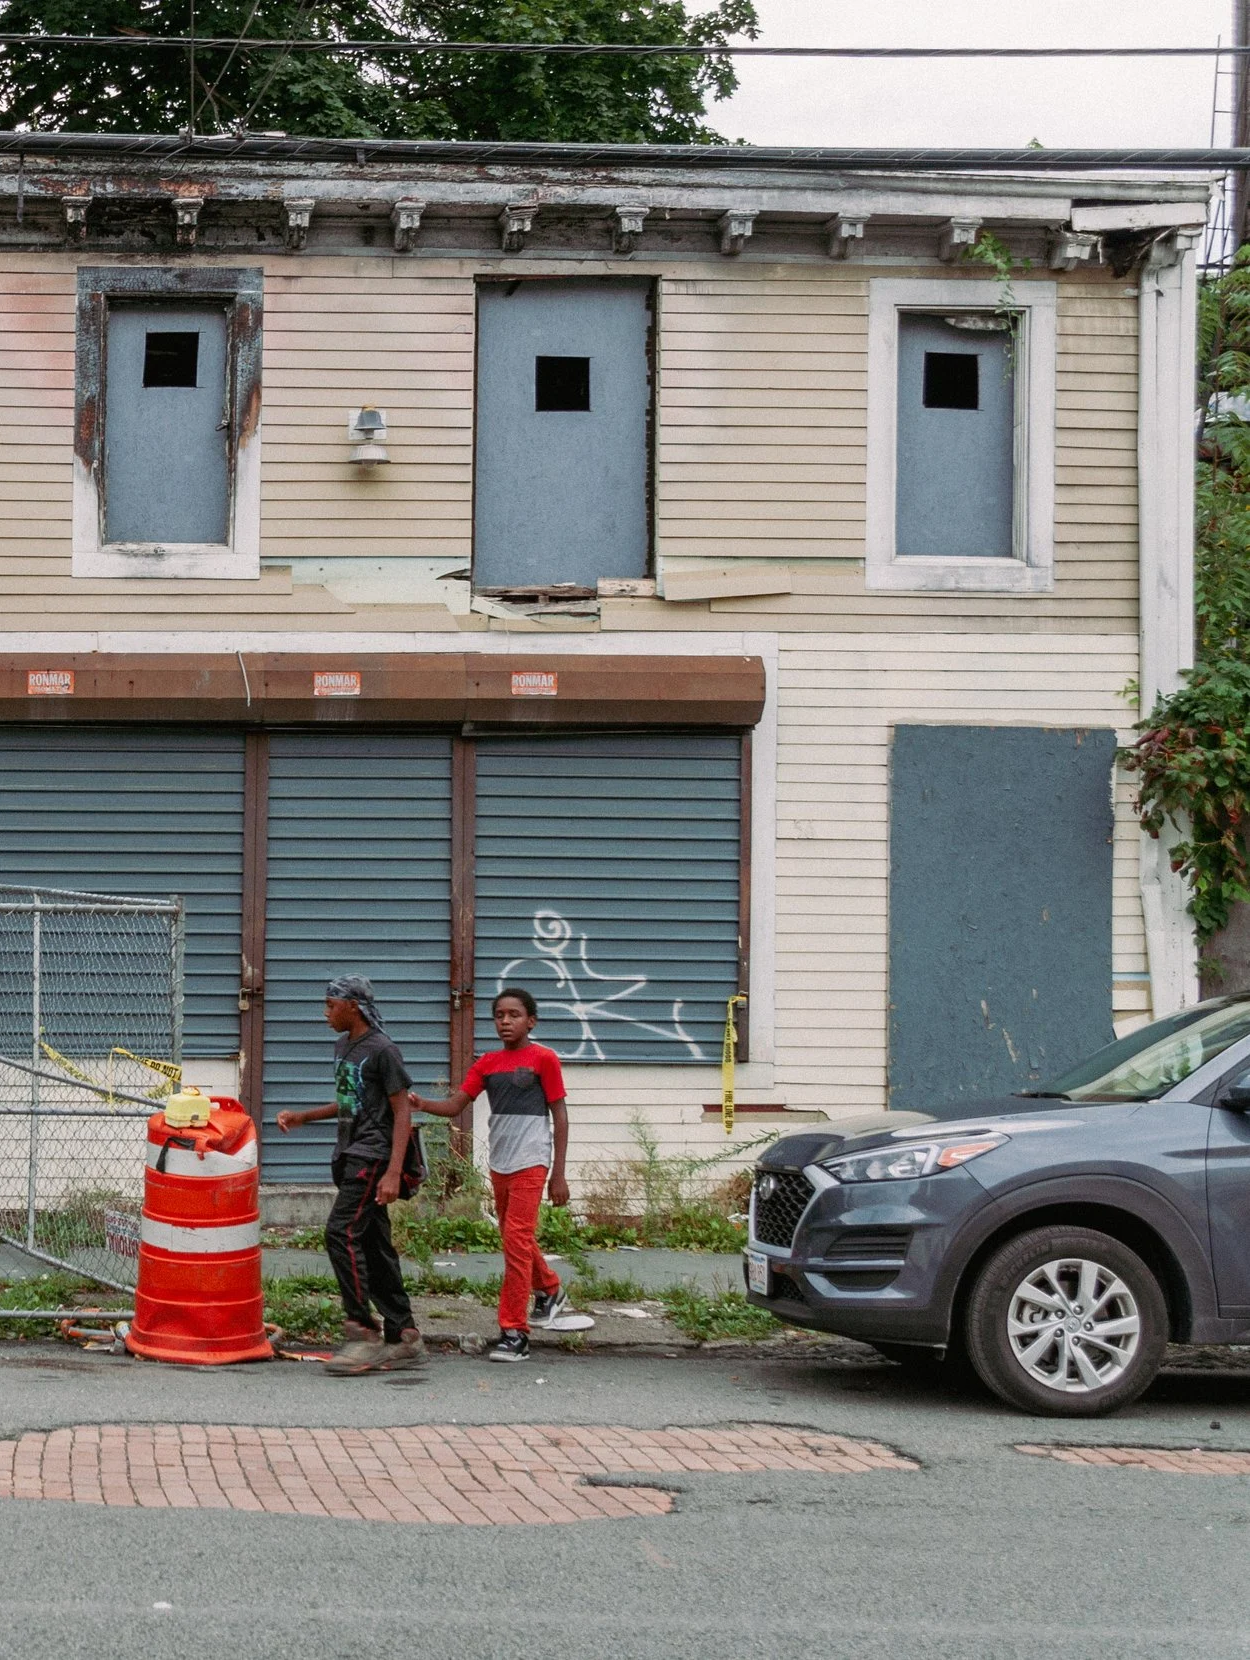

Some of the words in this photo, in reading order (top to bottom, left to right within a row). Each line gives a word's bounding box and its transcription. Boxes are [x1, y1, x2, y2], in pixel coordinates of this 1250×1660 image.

[29, 673, 71, 686] RONMAR
[315, 674, 357, 687] RONMAR
[512, 674, 554, 687] RONMAR
[150, 1061, 161, 1071] DO
[163, 1064, 179, 1078] NOT
[725, 1090, 733, 1102] FIRE
[725, 1104, 734, 1119] LINE
